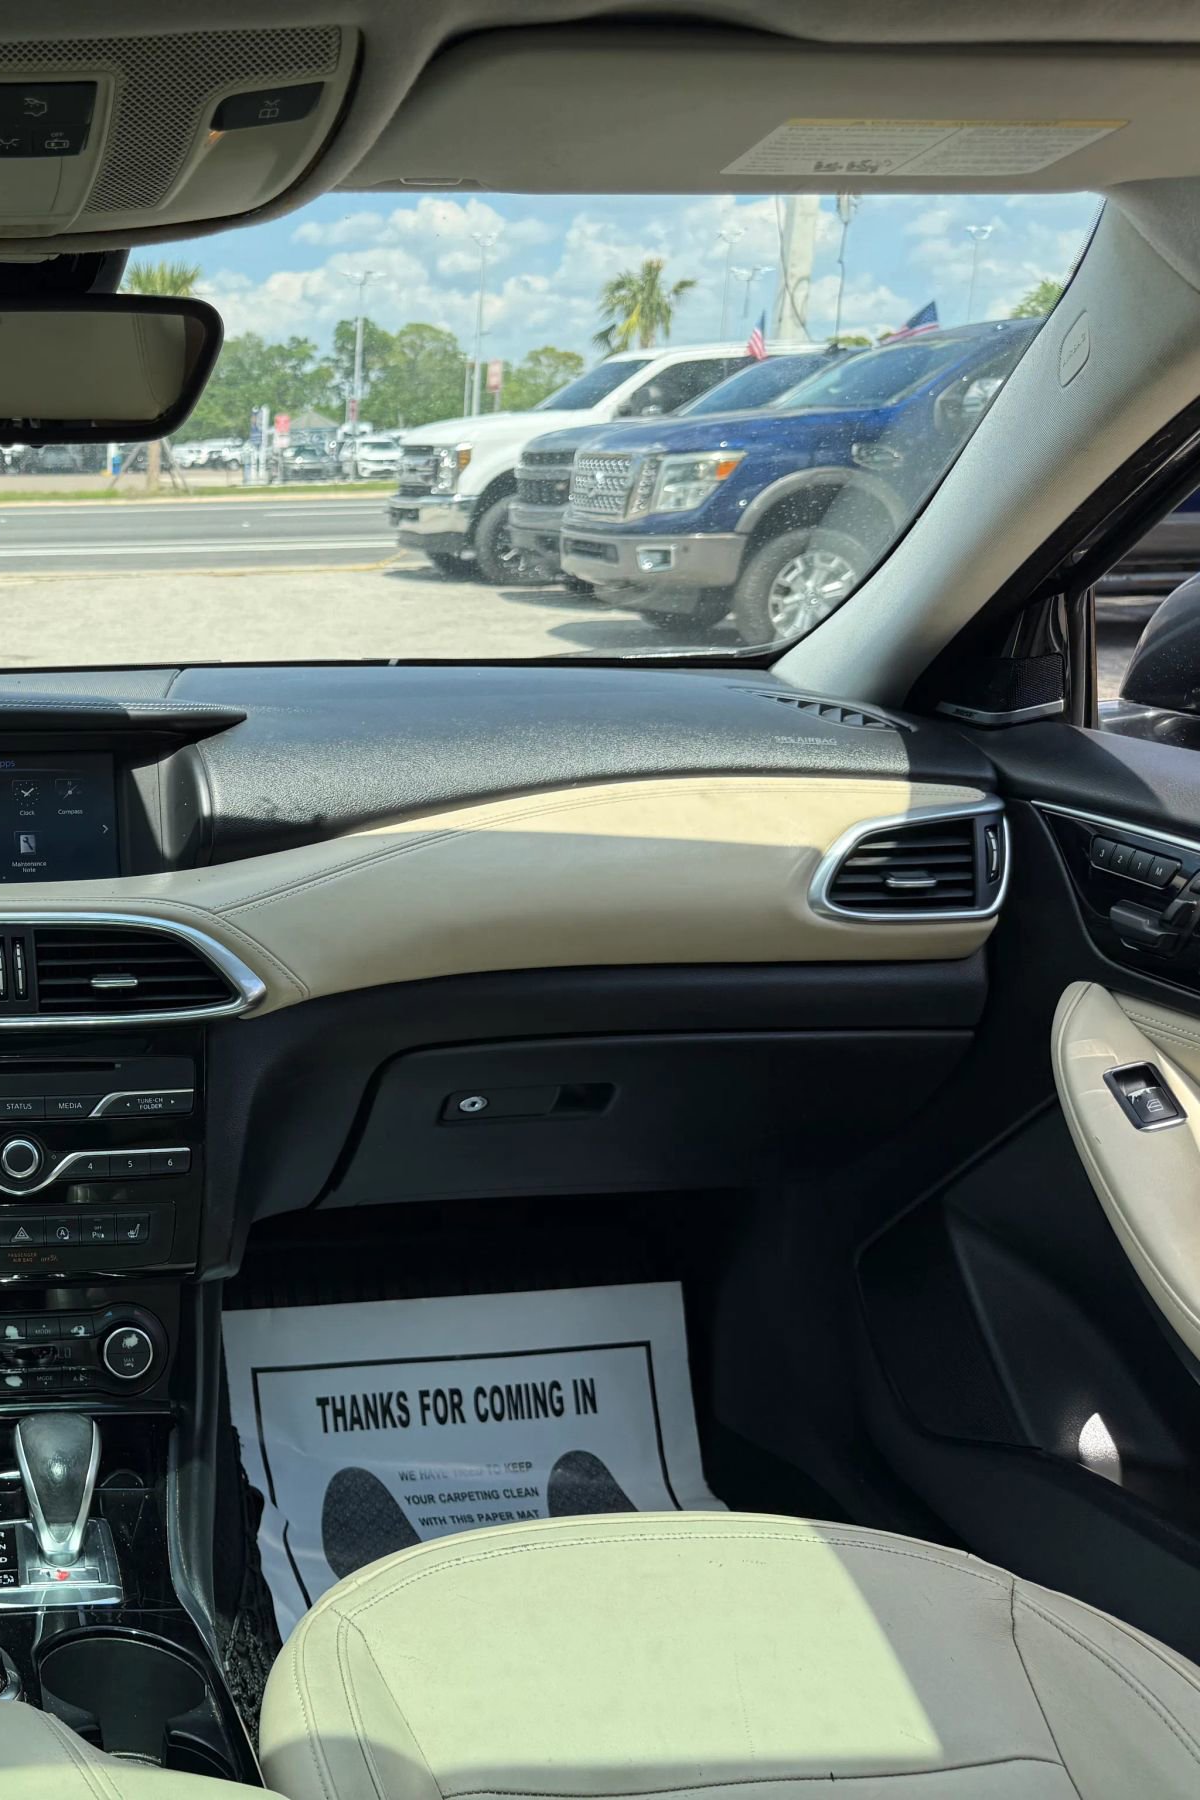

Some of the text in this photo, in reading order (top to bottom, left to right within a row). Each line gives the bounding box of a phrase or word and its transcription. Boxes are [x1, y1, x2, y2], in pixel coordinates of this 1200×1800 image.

[128, 1160, 133, 1168] 5
[167, 1158, 173, 1166] 6
[316, 1378, 598, 1434] THANKS FOR COMING IN
[398, 1470, 416, 1481] WE
[420, 1468, 448, 1480] HAVE
[504, 1461, 532, 1474] KEEP
[404, 1486, 539, 1506] YOUR CARPETING CLEAN
[418, 1509, 540, 1526] WITH THIS PAPER MAT
